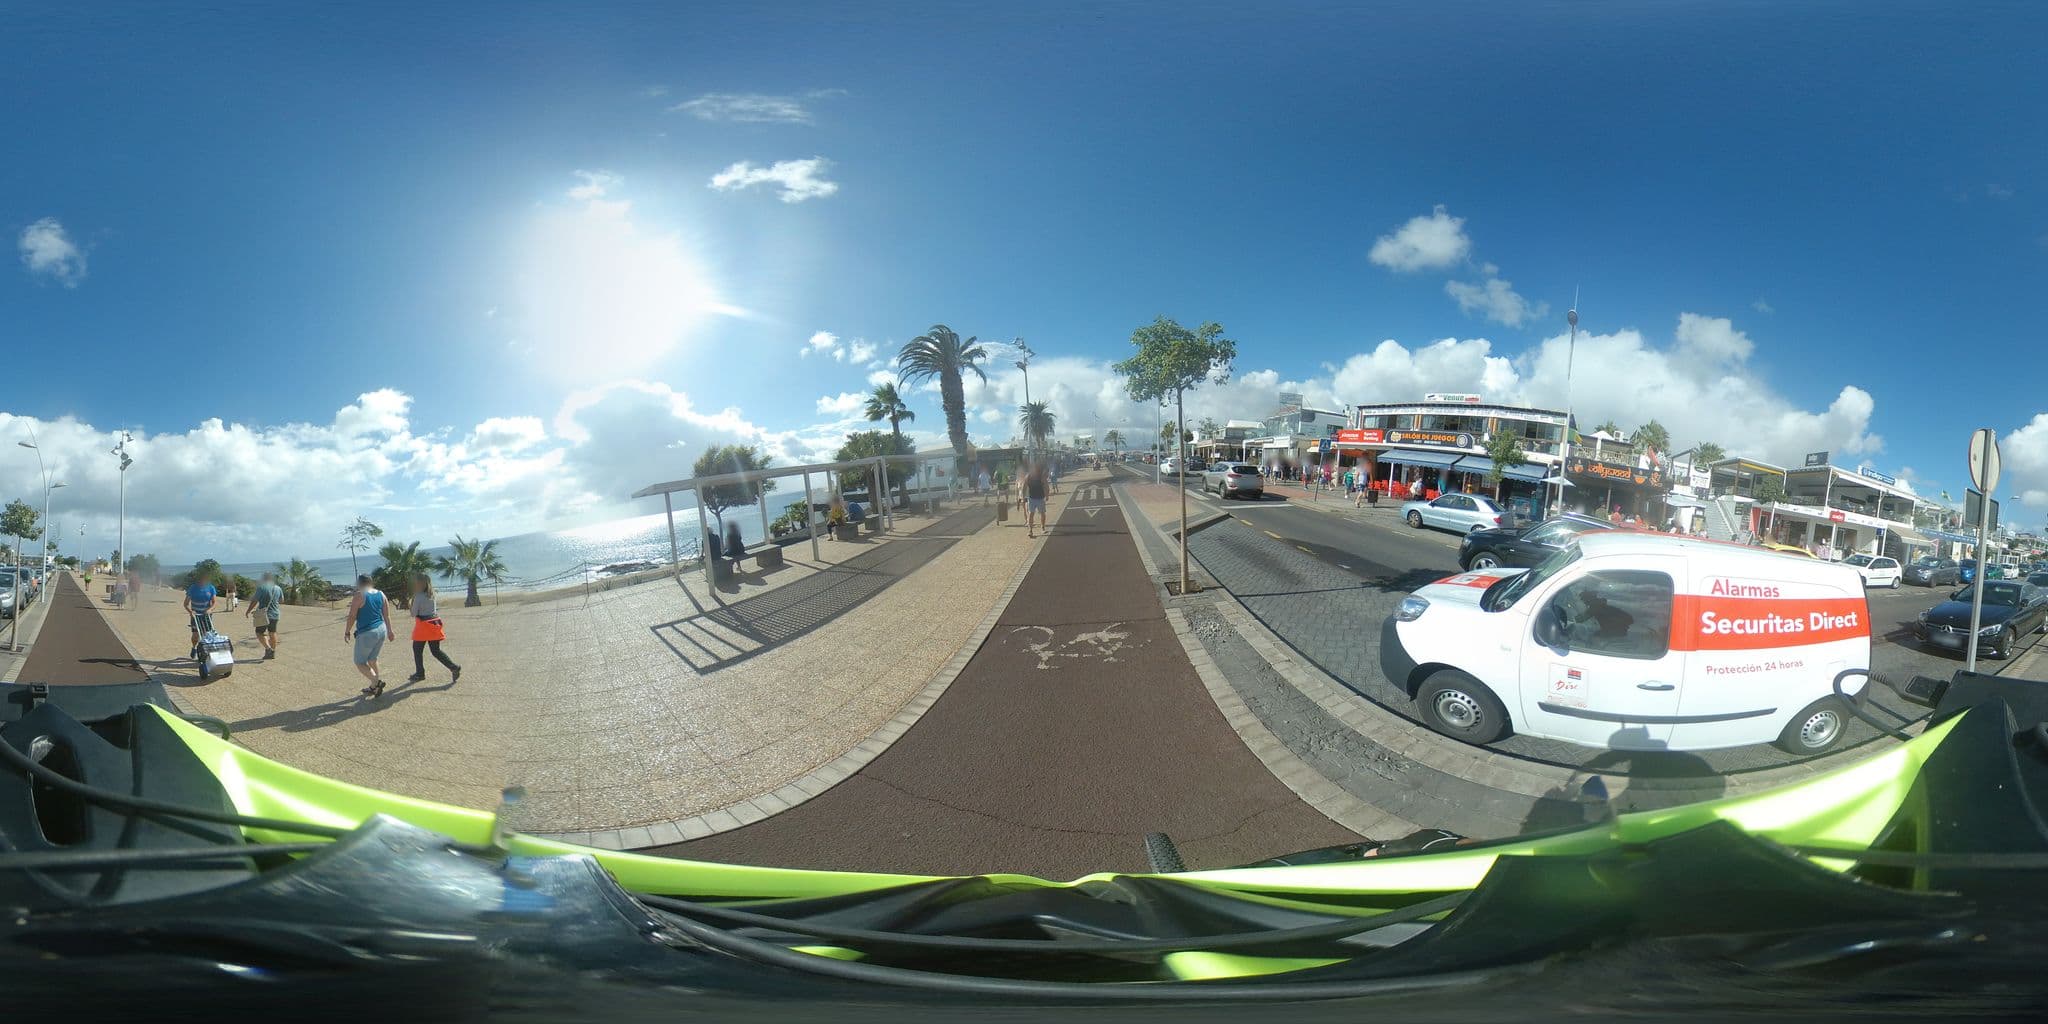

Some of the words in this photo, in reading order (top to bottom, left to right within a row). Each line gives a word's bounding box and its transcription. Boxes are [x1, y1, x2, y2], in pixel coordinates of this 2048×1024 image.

[1711, 579, 1780, 598] Alarmas
[1701, 611, 1804, 634] Securitas
[1809, 611, 1858, 631] Direct
[1706, 664, 1762, 675] Protección
[1764, 661, 1777, 671] 24
[1779, 659, 1804, 670] horas
